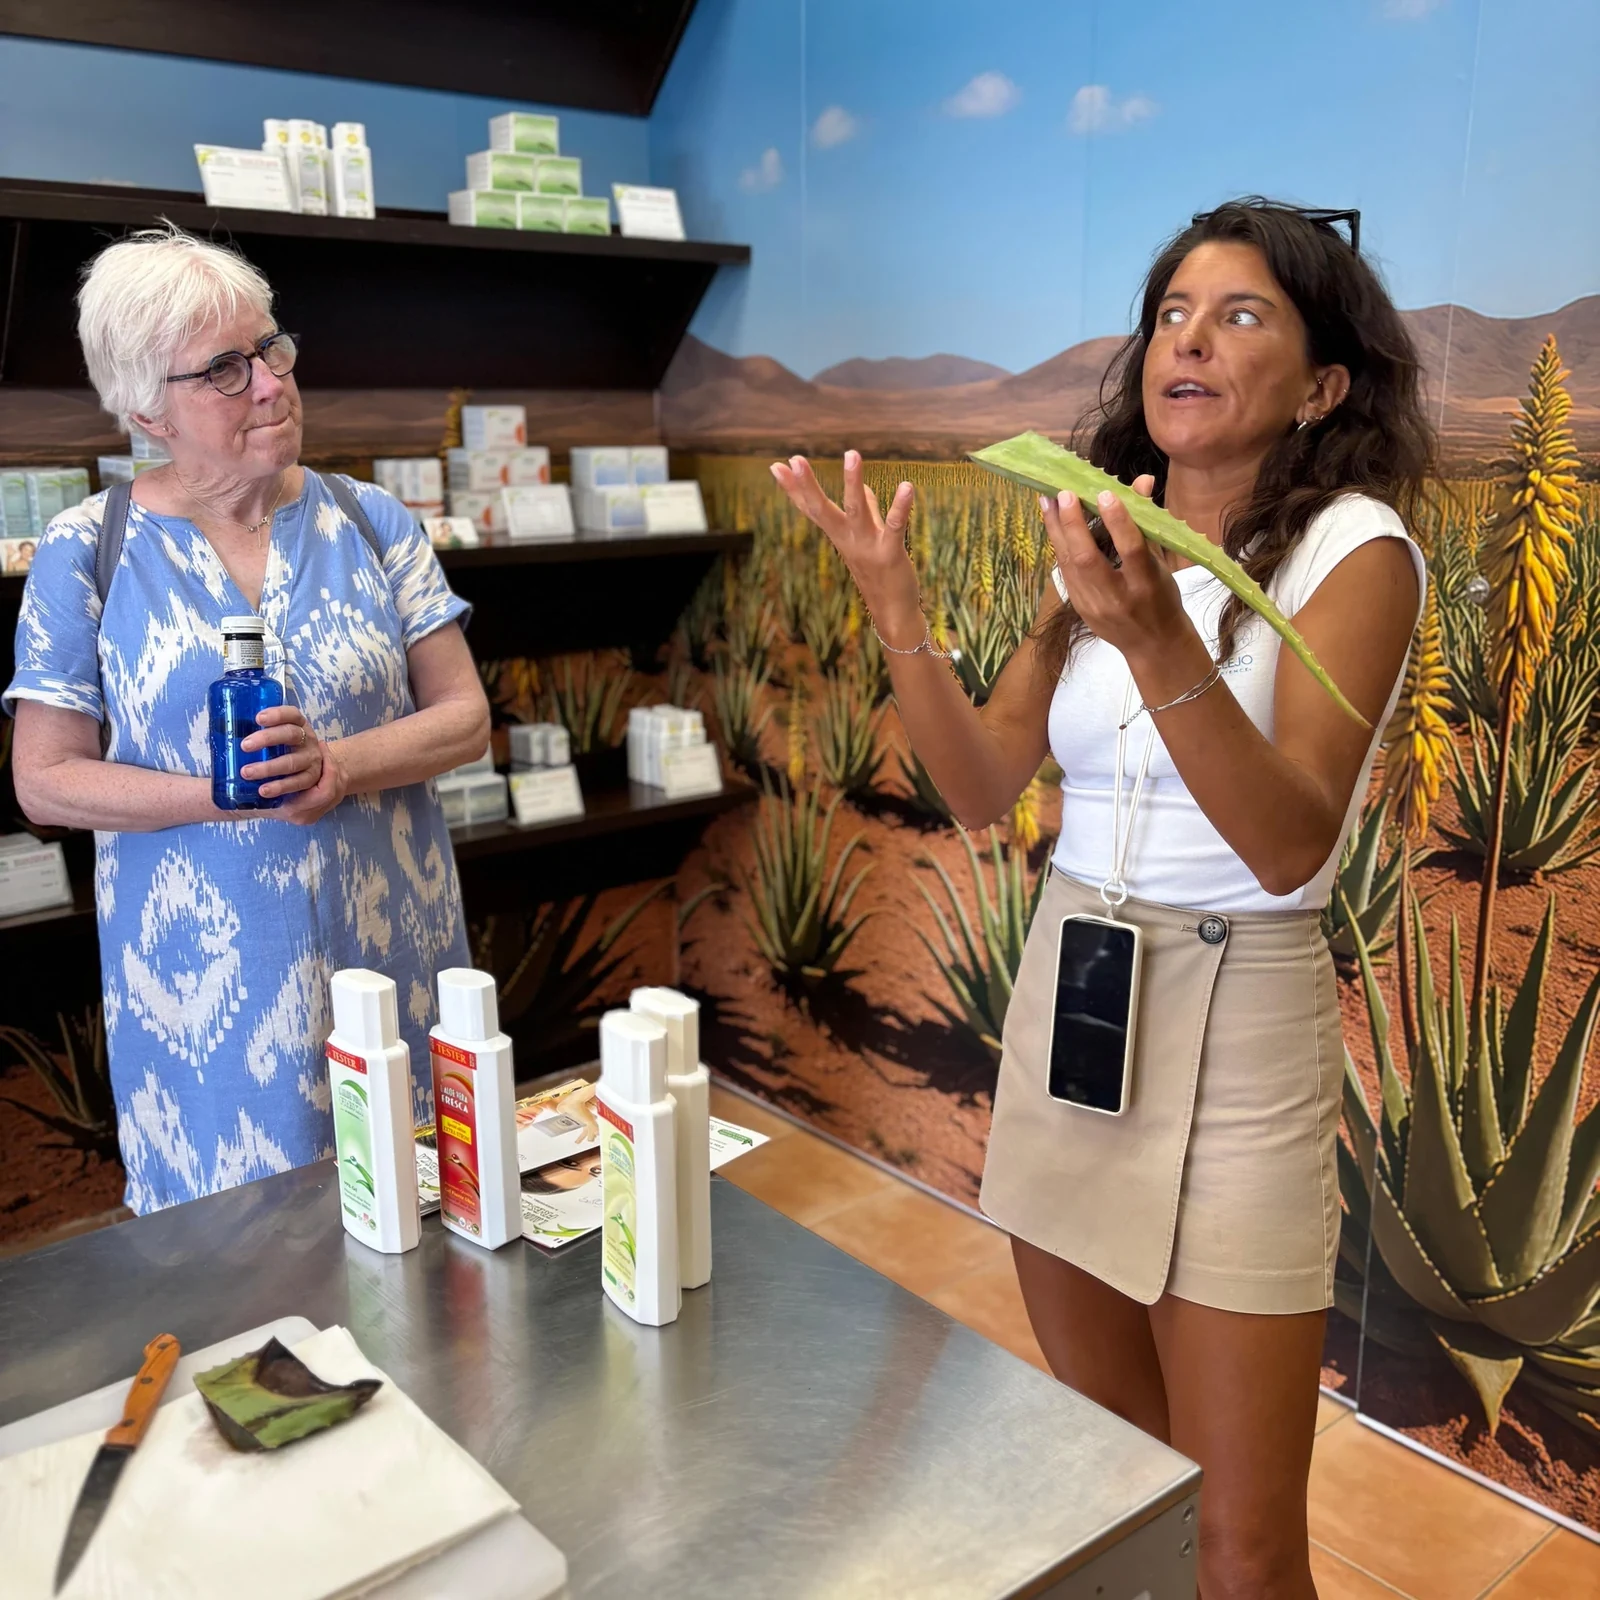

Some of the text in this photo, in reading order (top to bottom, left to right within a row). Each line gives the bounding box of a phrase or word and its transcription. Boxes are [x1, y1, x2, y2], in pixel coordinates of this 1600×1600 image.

[332, 1050, 357, 1069] TESTER
[436, 1043, 467, 1065] TESTER
[441, 1094, 469, 1114] FRESCA
